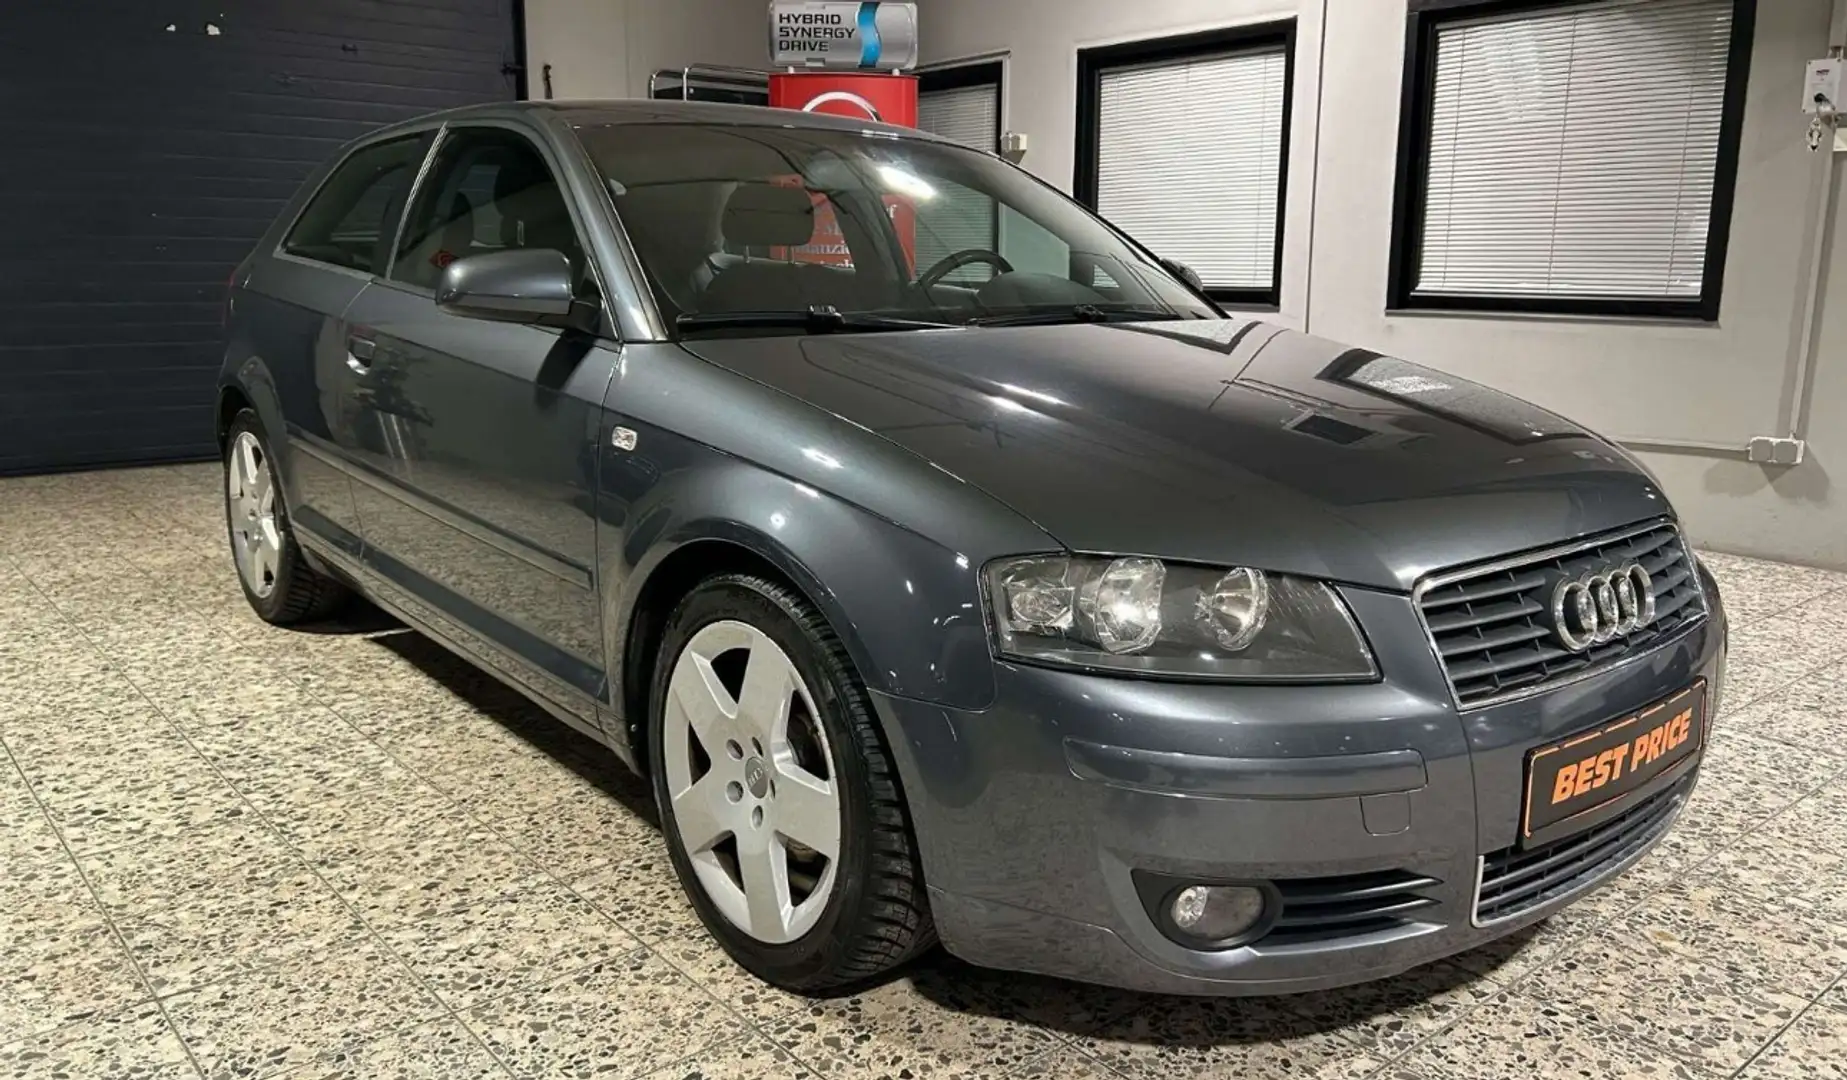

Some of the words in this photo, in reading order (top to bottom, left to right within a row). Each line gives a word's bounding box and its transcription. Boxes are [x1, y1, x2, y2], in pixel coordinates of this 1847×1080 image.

[779, 13, 841, 24] HYBRID
[779, 26, 855, 38] SYNERGY
[779, 40, 828, 52] DRIVE
[1552, 743, 1629, 804] BEST
[1630, 707, 1692, 772] PRICE
